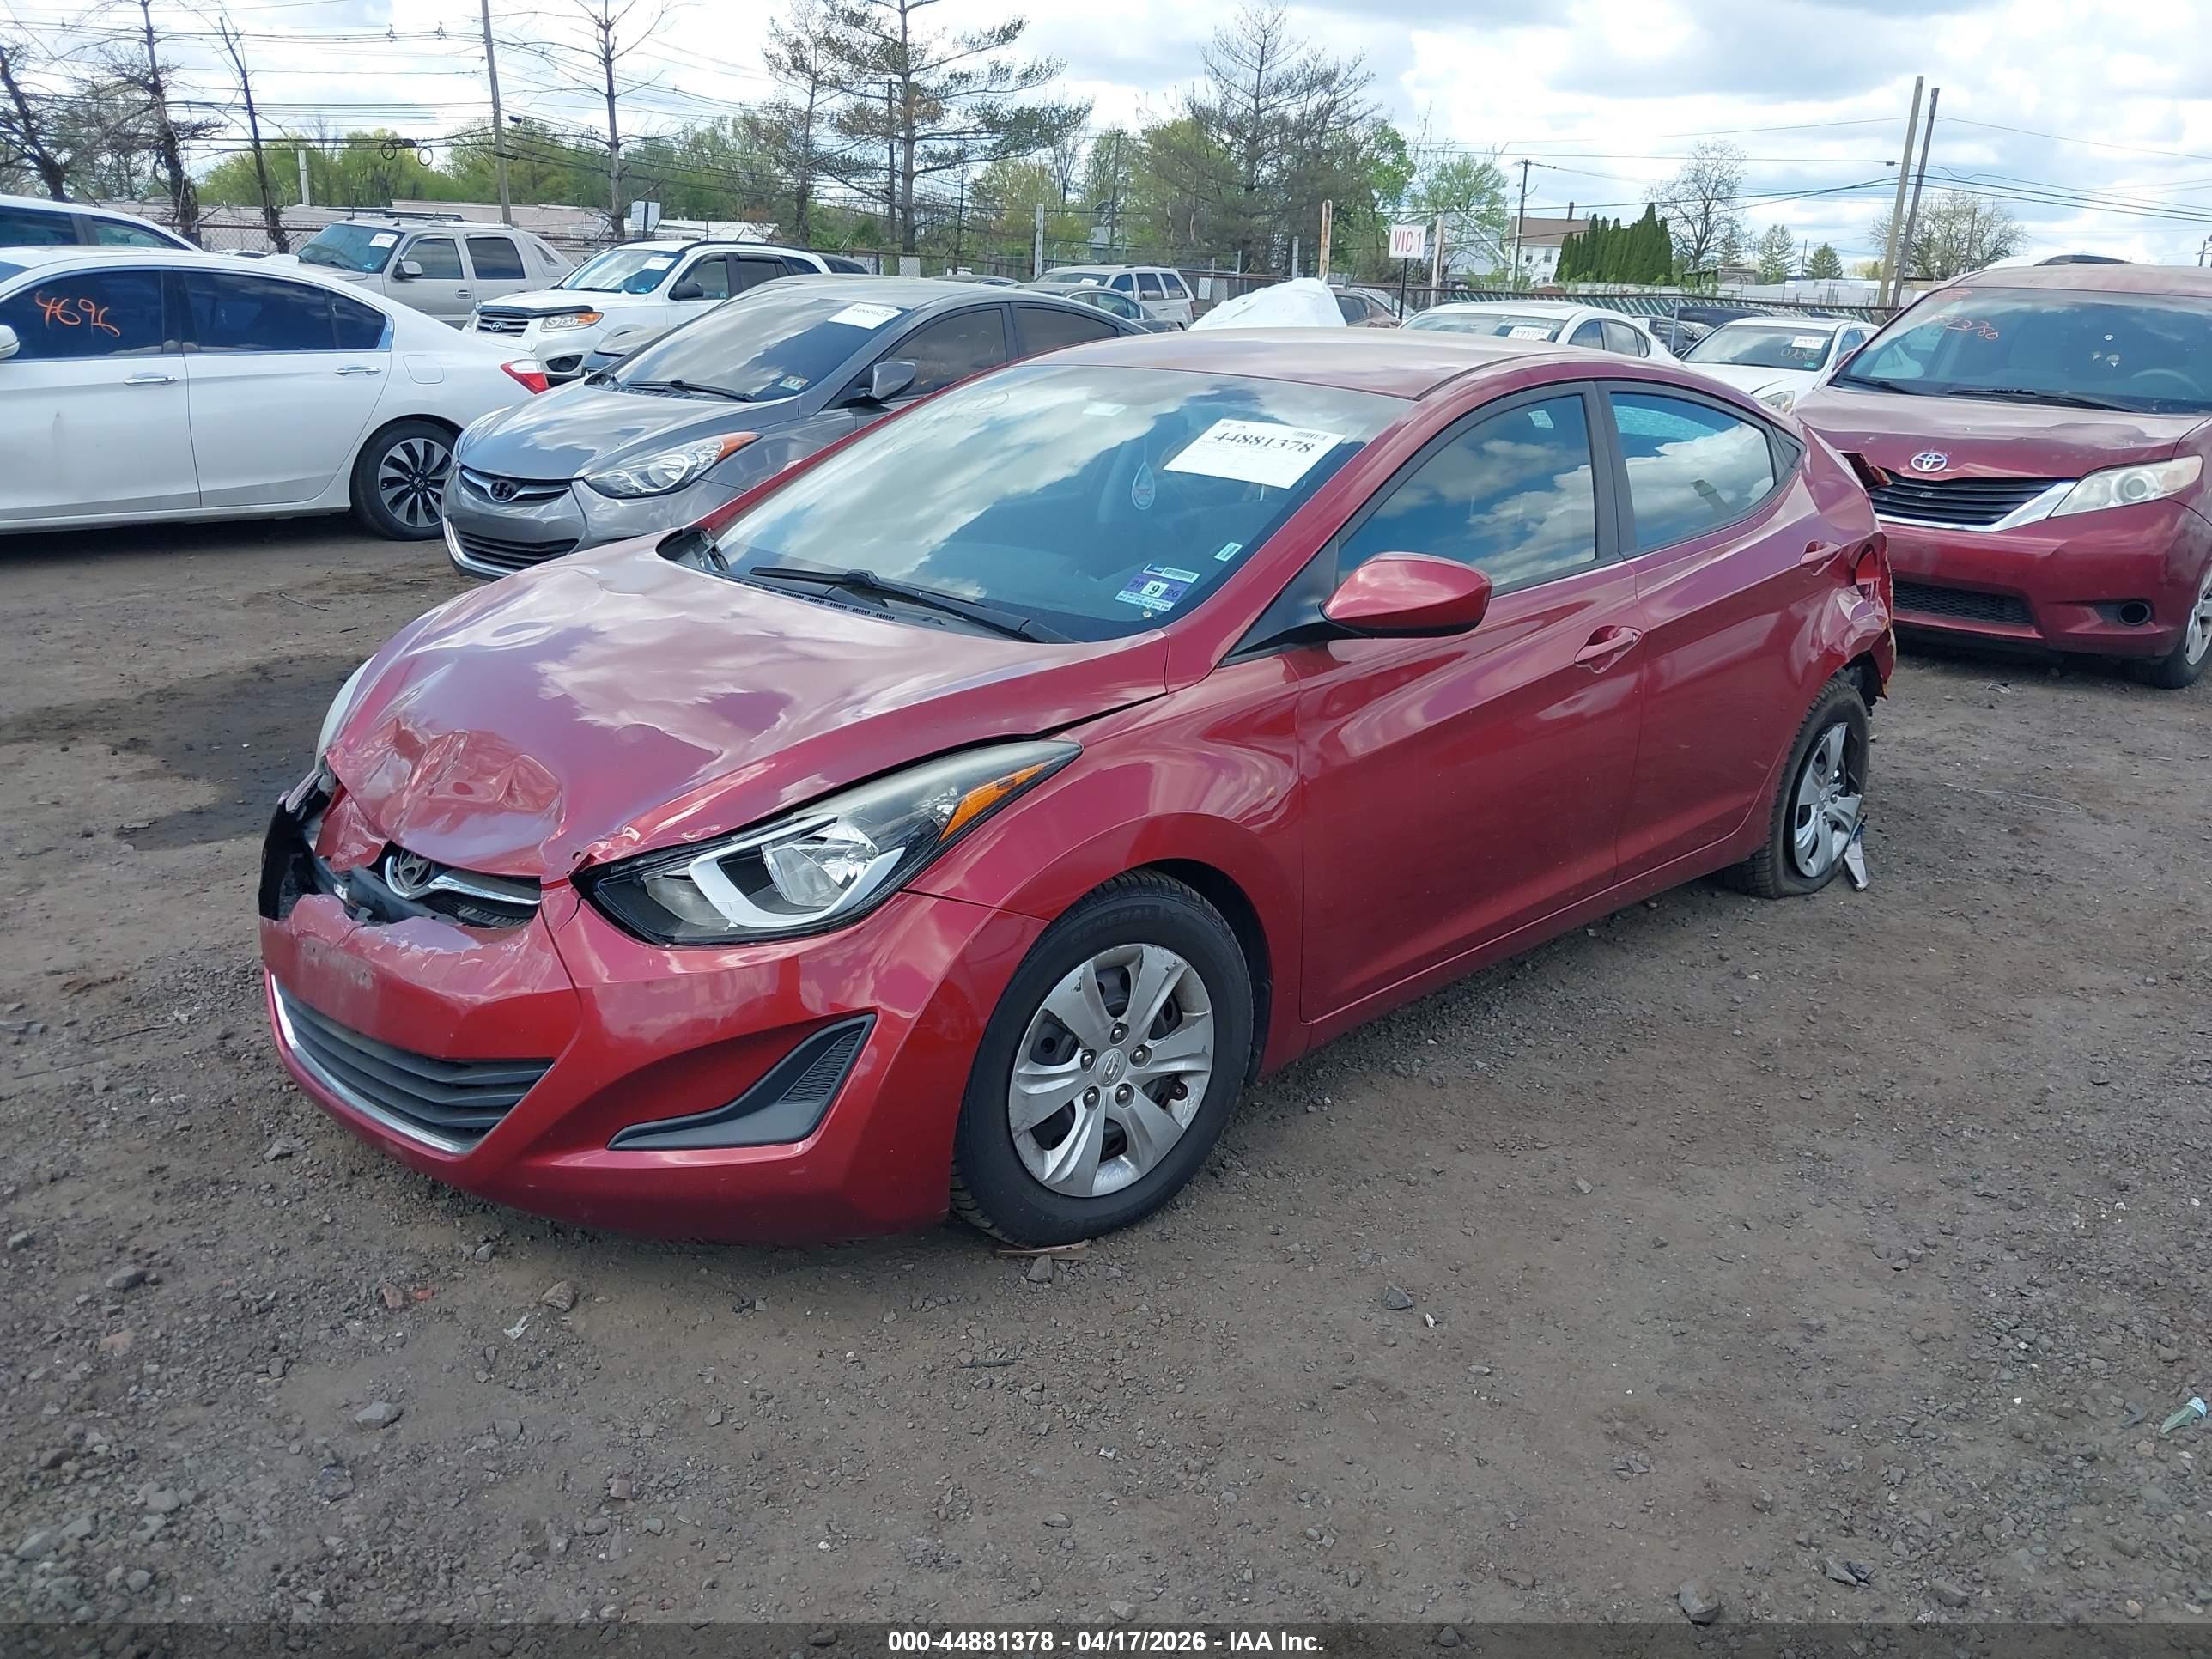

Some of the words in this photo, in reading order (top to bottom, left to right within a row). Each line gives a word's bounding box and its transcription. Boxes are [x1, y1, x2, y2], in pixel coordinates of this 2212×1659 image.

[1394, 230, 1413, 252] VIC
[1417, 232, 1422, 253] 1
[34, 290, 121, 337] 4696
[1213, 431, 1316, 454] 44881378
[1129, 580, 1146, 589] 20
[1149, 584, 1161, 595] 9
[1164, 588, 1181, 598] 26
